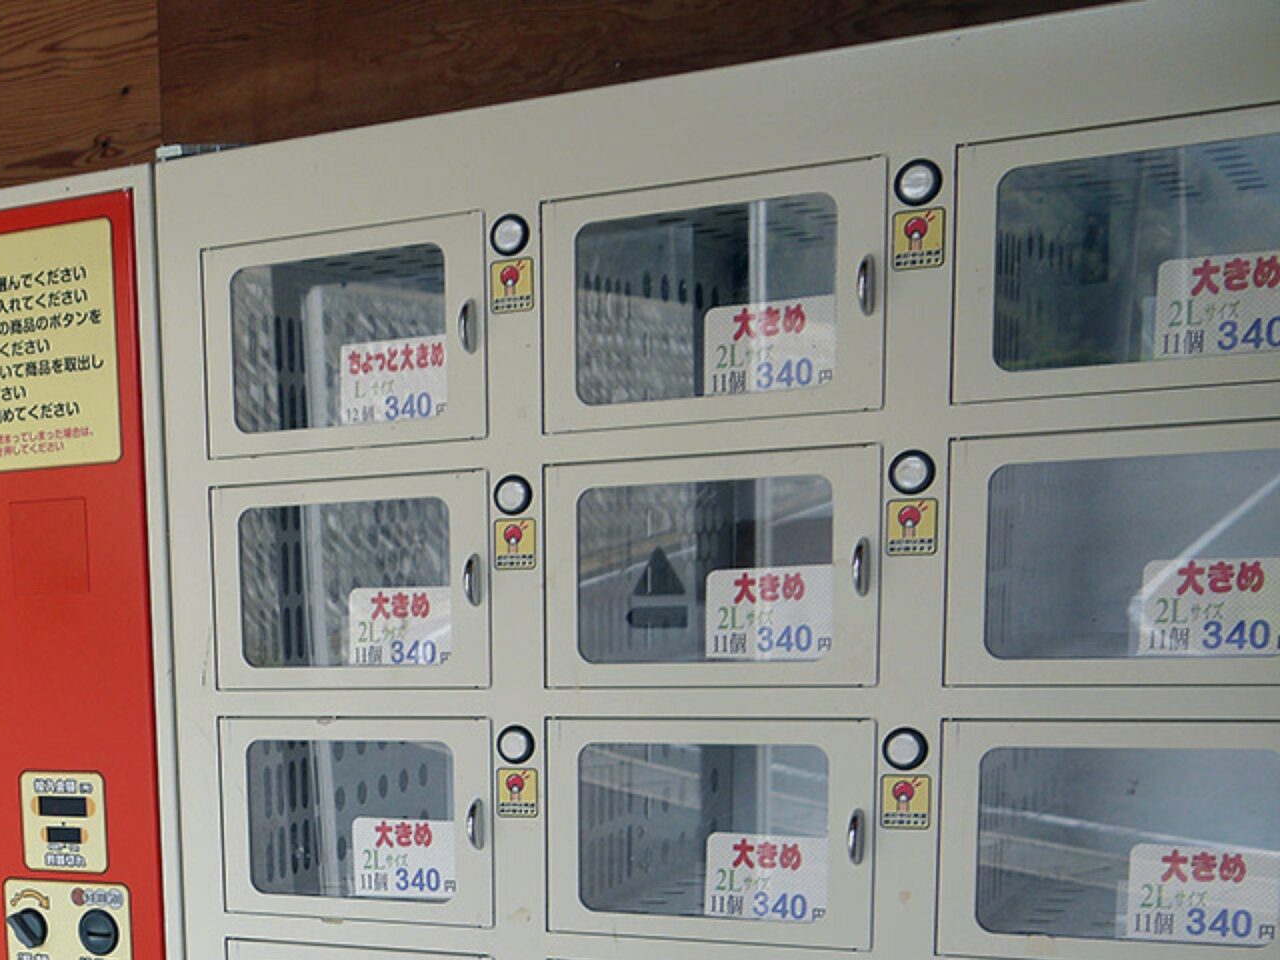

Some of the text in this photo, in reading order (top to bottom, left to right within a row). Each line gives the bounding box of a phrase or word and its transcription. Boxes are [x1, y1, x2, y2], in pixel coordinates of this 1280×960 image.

[1192, 255, 1280, 296] 大きめ
[733, 304, 805, 341] 大きめ
[1168, 299, 1240, 326] 2Lサイズ
[1163, 330, 1204, 354] 11個
[348, 343, 445, 375] ちょっと大きめ
[712, 358, 832, 393] 11個 340円
[734, 572, 805, 604] 大きめ
[1176, 561, 1264, 595] 大きめ
[371, 591, 430, 620] 大きめ
[1155, 598, 1225, 624] 2Lサイズ
[713, 625, 832, 654] 11個 340円
[1149, 628, 1189, 650] 11個
[355, 646, 382, 665] 11個
[375, 821, 432, 848] 大きめ
[732, 839, 801, 870] 大きめ
[1162, 849, 1246, 882] 大きめ
[361, 868, 456, 892] 11個 340円
[711, 892, 826, 920] 11個 340円
[1141, 884, 1207, 908] 2Lサイズ
[1135, 909, 1274, 938] 11個 340円
